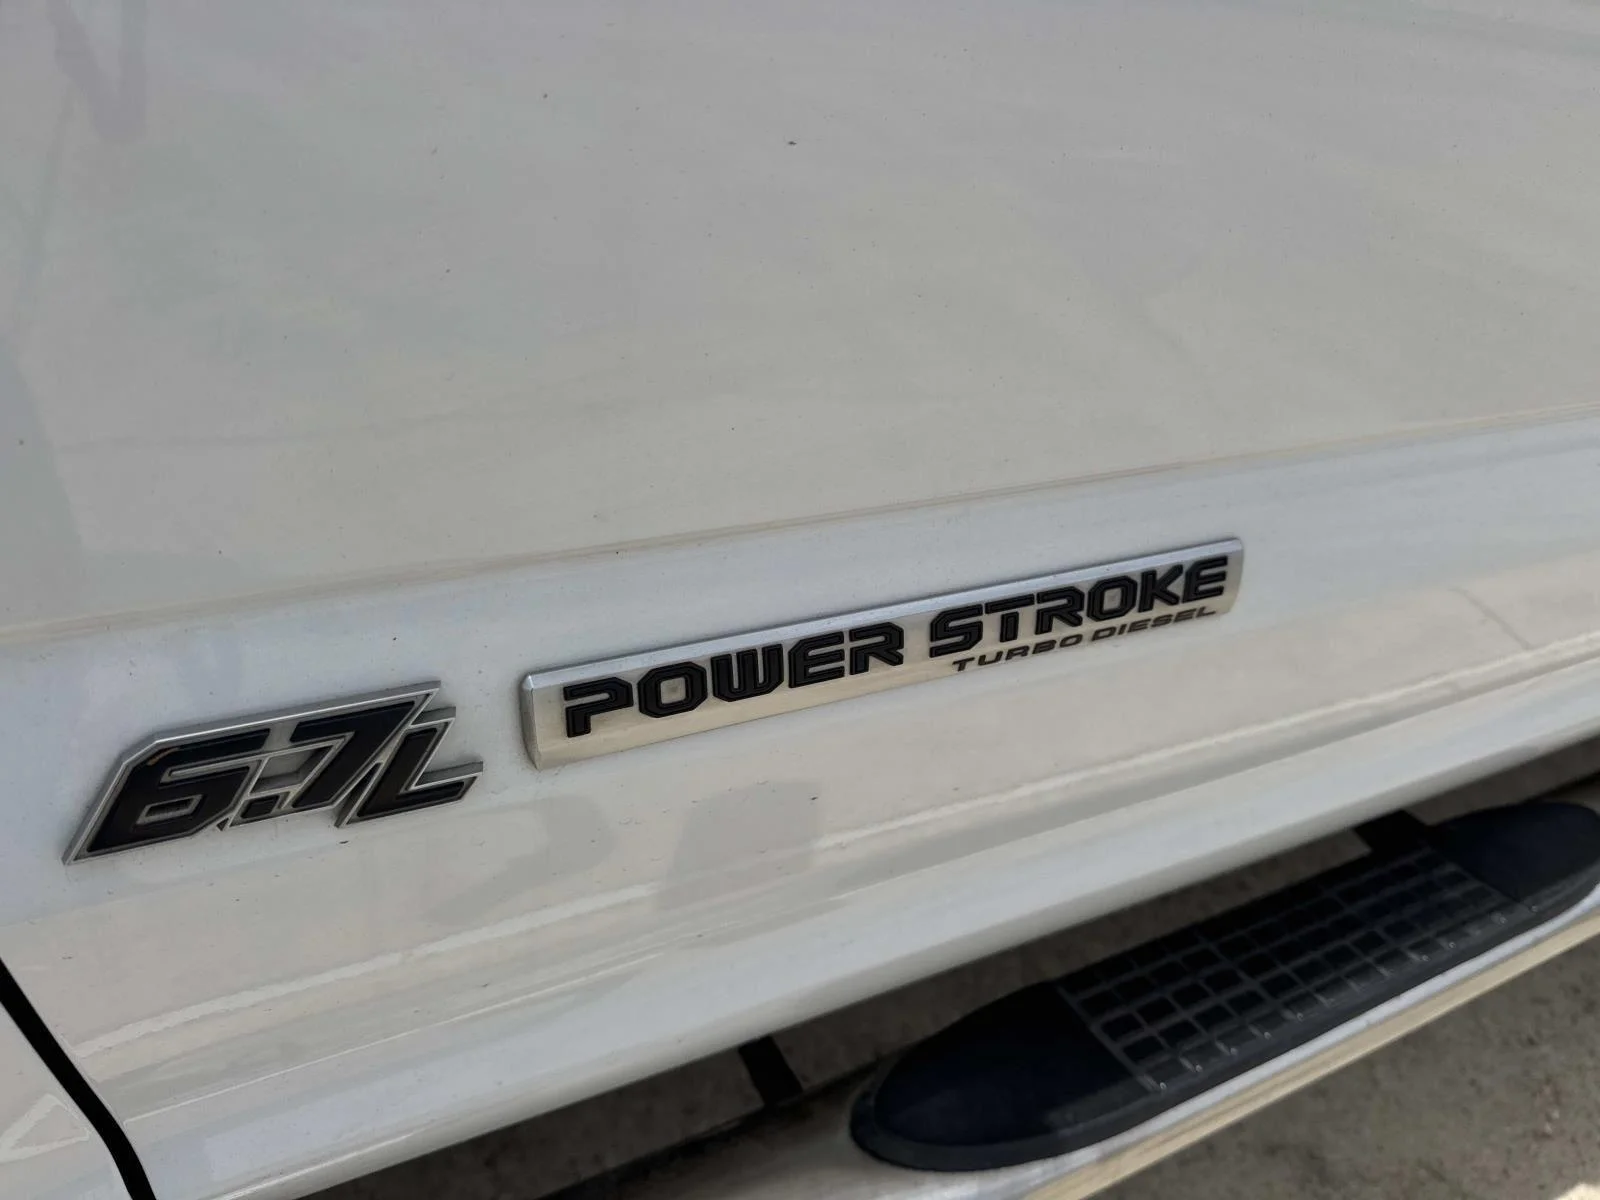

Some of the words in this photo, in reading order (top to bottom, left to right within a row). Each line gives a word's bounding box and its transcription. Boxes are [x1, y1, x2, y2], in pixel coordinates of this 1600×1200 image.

[563, 621, 905, 738] POWER
[928, 555, 1229, 658] STROKE
[952, 634, 1083, 672] TURBO
[1091, 606, 1217, 642] DIESEL
[64, 681, 483, 864] 6.7L
